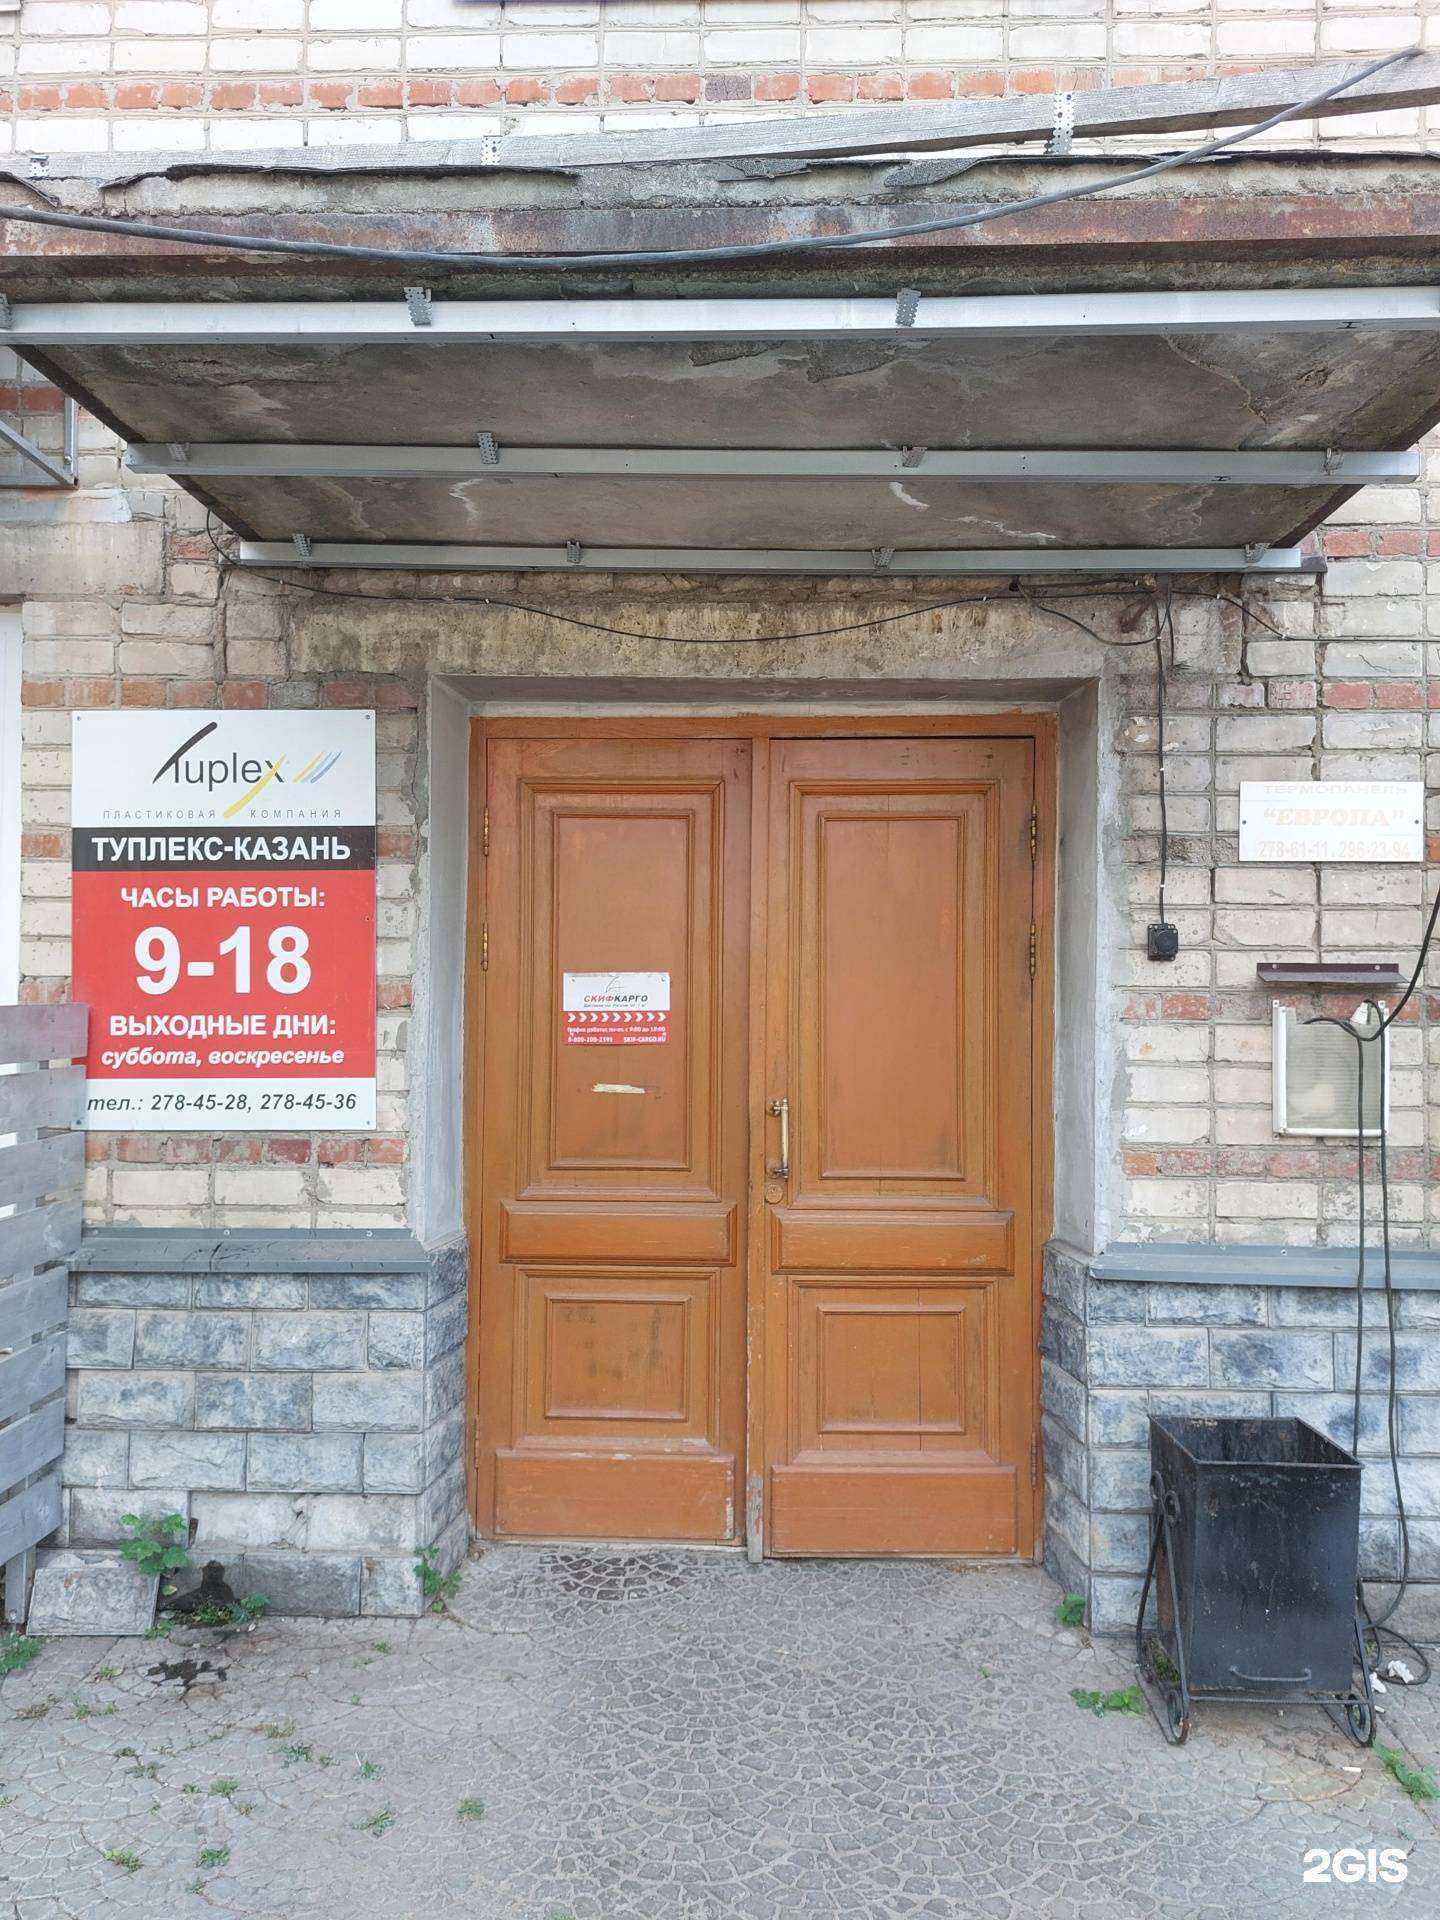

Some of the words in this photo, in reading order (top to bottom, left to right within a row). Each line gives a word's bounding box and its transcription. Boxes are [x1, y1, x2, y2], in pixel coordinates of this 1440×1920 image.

[152, 721, 287, 792] Tuplex
[1264, 785, 1407, 795] ТЕРМОПАНЕЛЬ
[103, 809, 216, 819] ПЛАСТИКОВАЯ
[250, 808, 342, 819] КОМПАНИЯ
[91, 837, 351, 861] ТУПЛЕКС-КАЗАНЬ
[120, 887, 199, 909] ЧАСЫ
[207, 886, 326, 908] РАБОТЫ:
[134, 925, 312, 995] 9-18
[583, 994, 649, 1003] СКИФКАРГО
[109, 1014, 267, 1039] ВЫХОДНЫЕ
[273, 1013, 336, 1039] ДНИ:
[101, 1046, 202, 1069] суббота,
[208, 1048, 345, 1068] воскресенье
[87, 1096, 142, 1111] тел.:
[151, 1094, 253, 1113] 278-45-28,
[260, 1093, 357, 1110] 278-45-36
